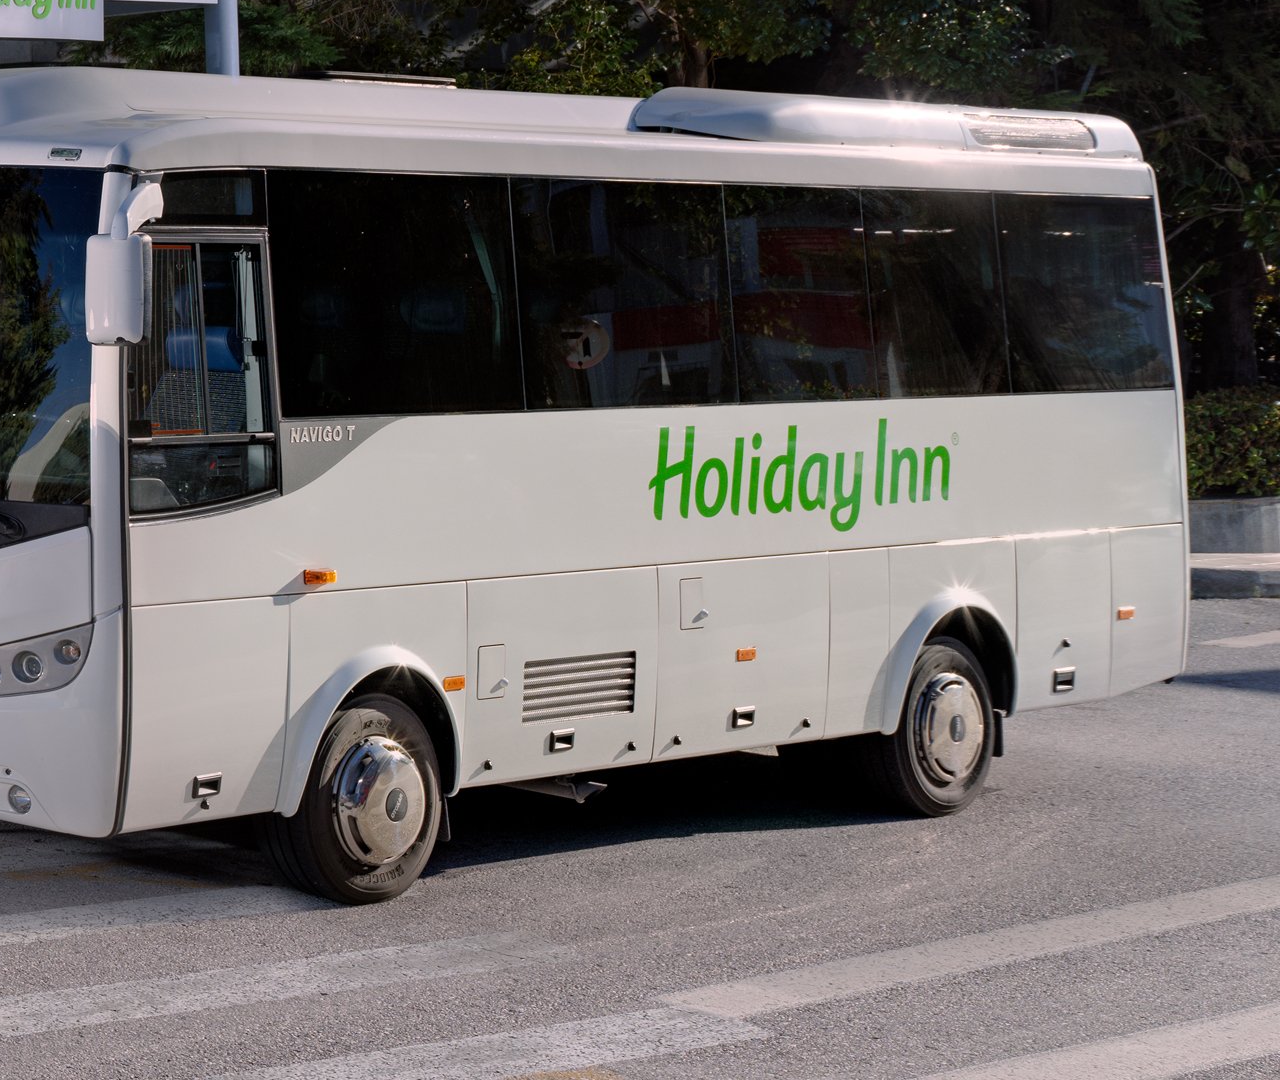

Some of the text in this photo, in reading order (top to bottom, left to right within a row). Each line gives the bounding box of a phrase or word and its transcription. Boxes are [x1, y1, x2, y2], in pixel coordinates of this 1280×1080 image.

[290, 425, 356, 443] NAVIGO T
[648, 418, 951, 533] Holiday Inn
